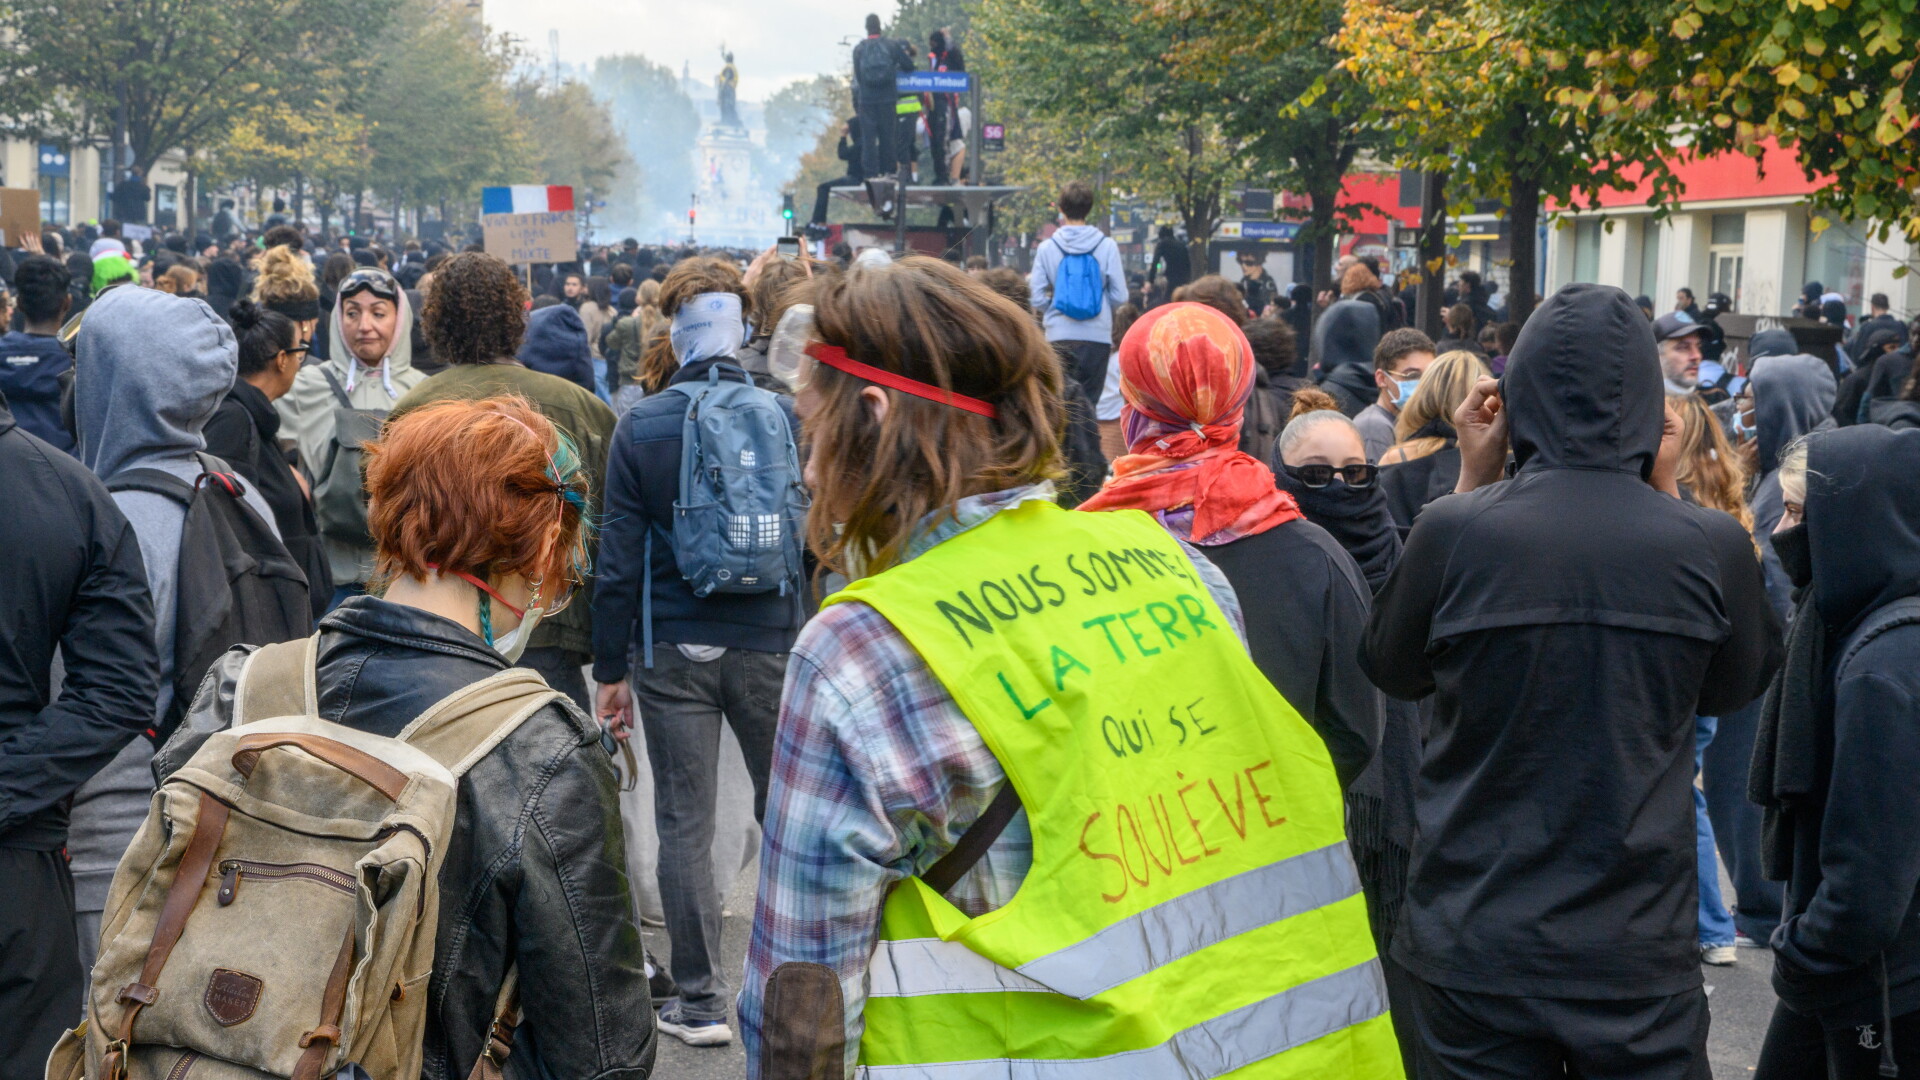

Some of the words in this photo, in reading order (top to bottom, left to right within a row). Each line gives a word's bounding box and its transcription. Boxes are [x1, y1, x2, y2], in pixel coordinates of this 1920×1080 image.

[896, 76, 932, 87] an-Pierre
[985, 126, 1003, 138] 56
[1243, 226, 1285, 237] Oberkampf
[934, 564, 1066, 650] NOUS
[996, 645, 1092, 721] LA
[1082, 594, 1218, 664] TERR
[1169, 697, 1218, 746] SE
[1078, 759, 1288, 904] SOULÈVE
